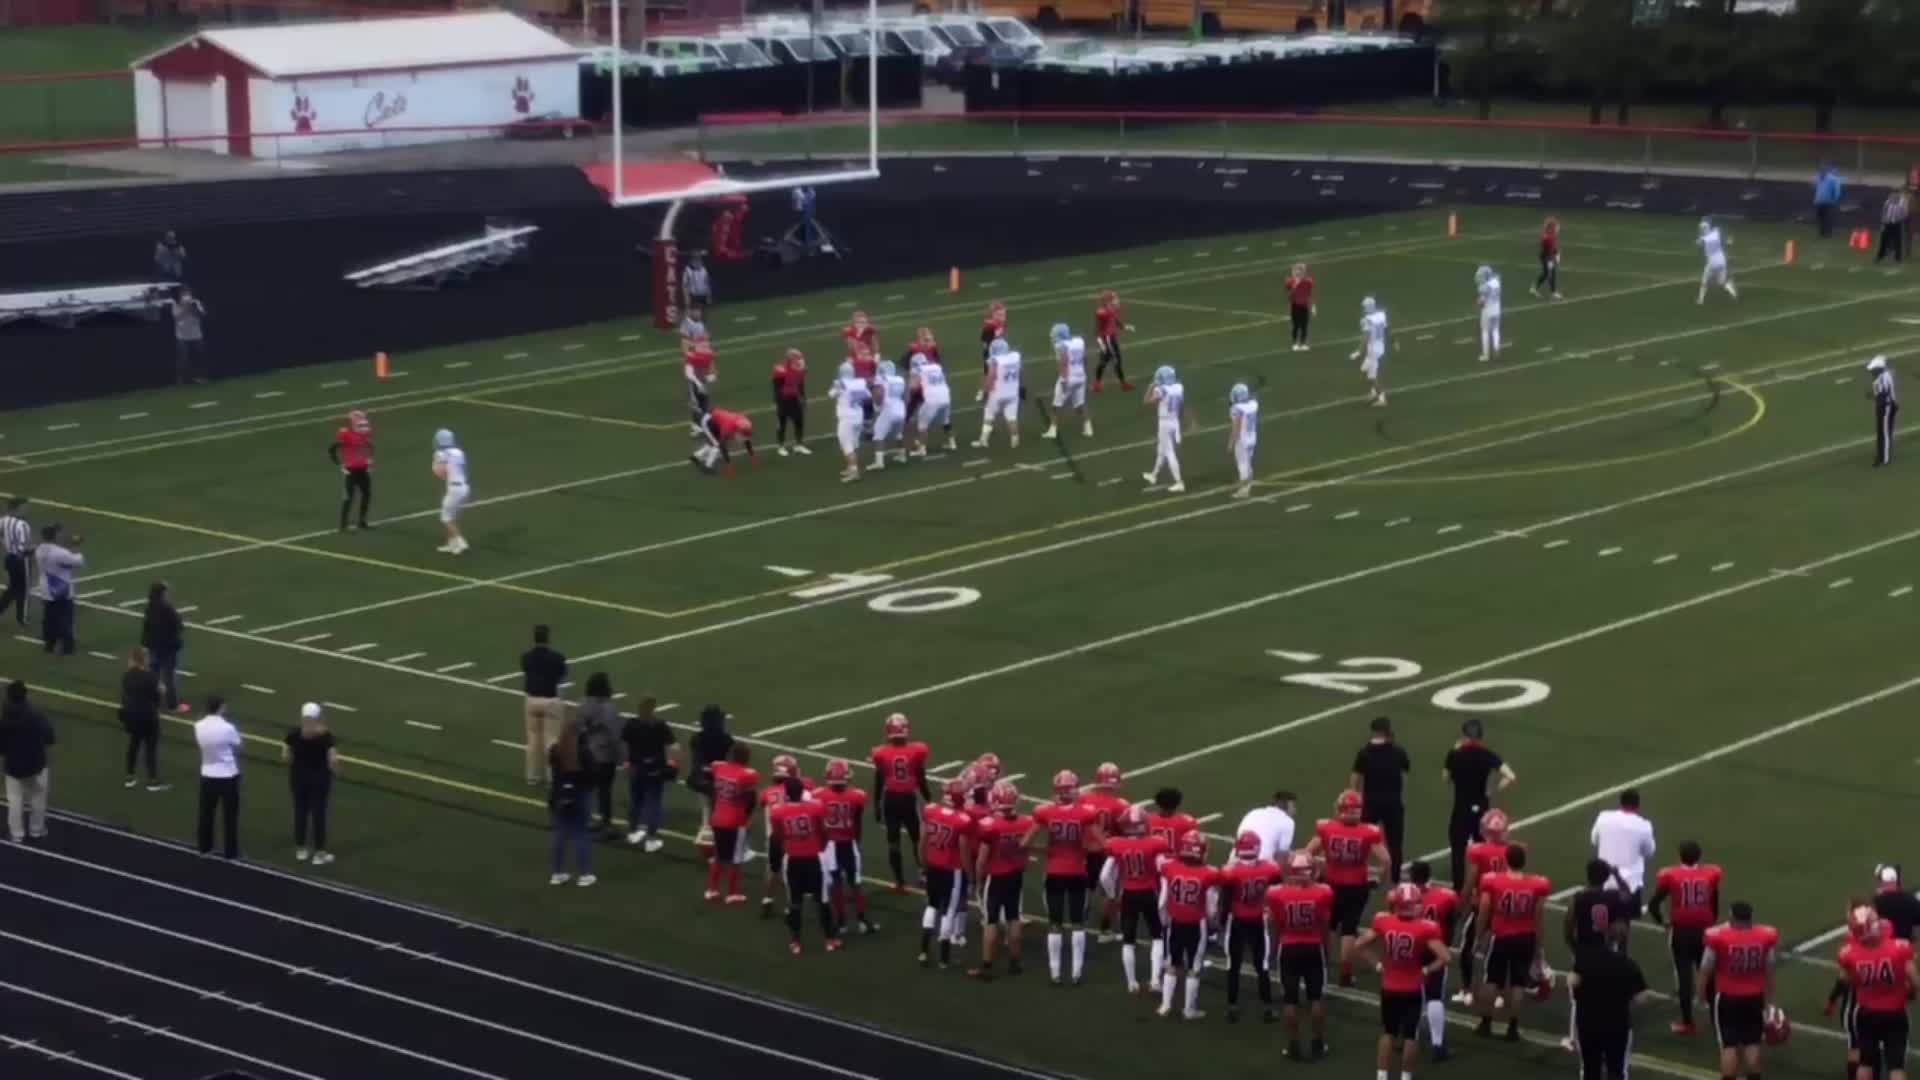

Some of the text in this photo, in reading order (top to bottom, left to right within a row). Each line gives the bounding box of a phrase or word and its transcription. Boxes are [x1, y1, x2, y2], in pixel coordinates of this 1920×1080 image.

[664, 246, 678, 322] CATS
[1280, 656, 1551, 711] 20
[892, 756, 910, 785] 6
[1170, 876, 1201, 905] 42
[1384, 930, 1414, 960] 12
